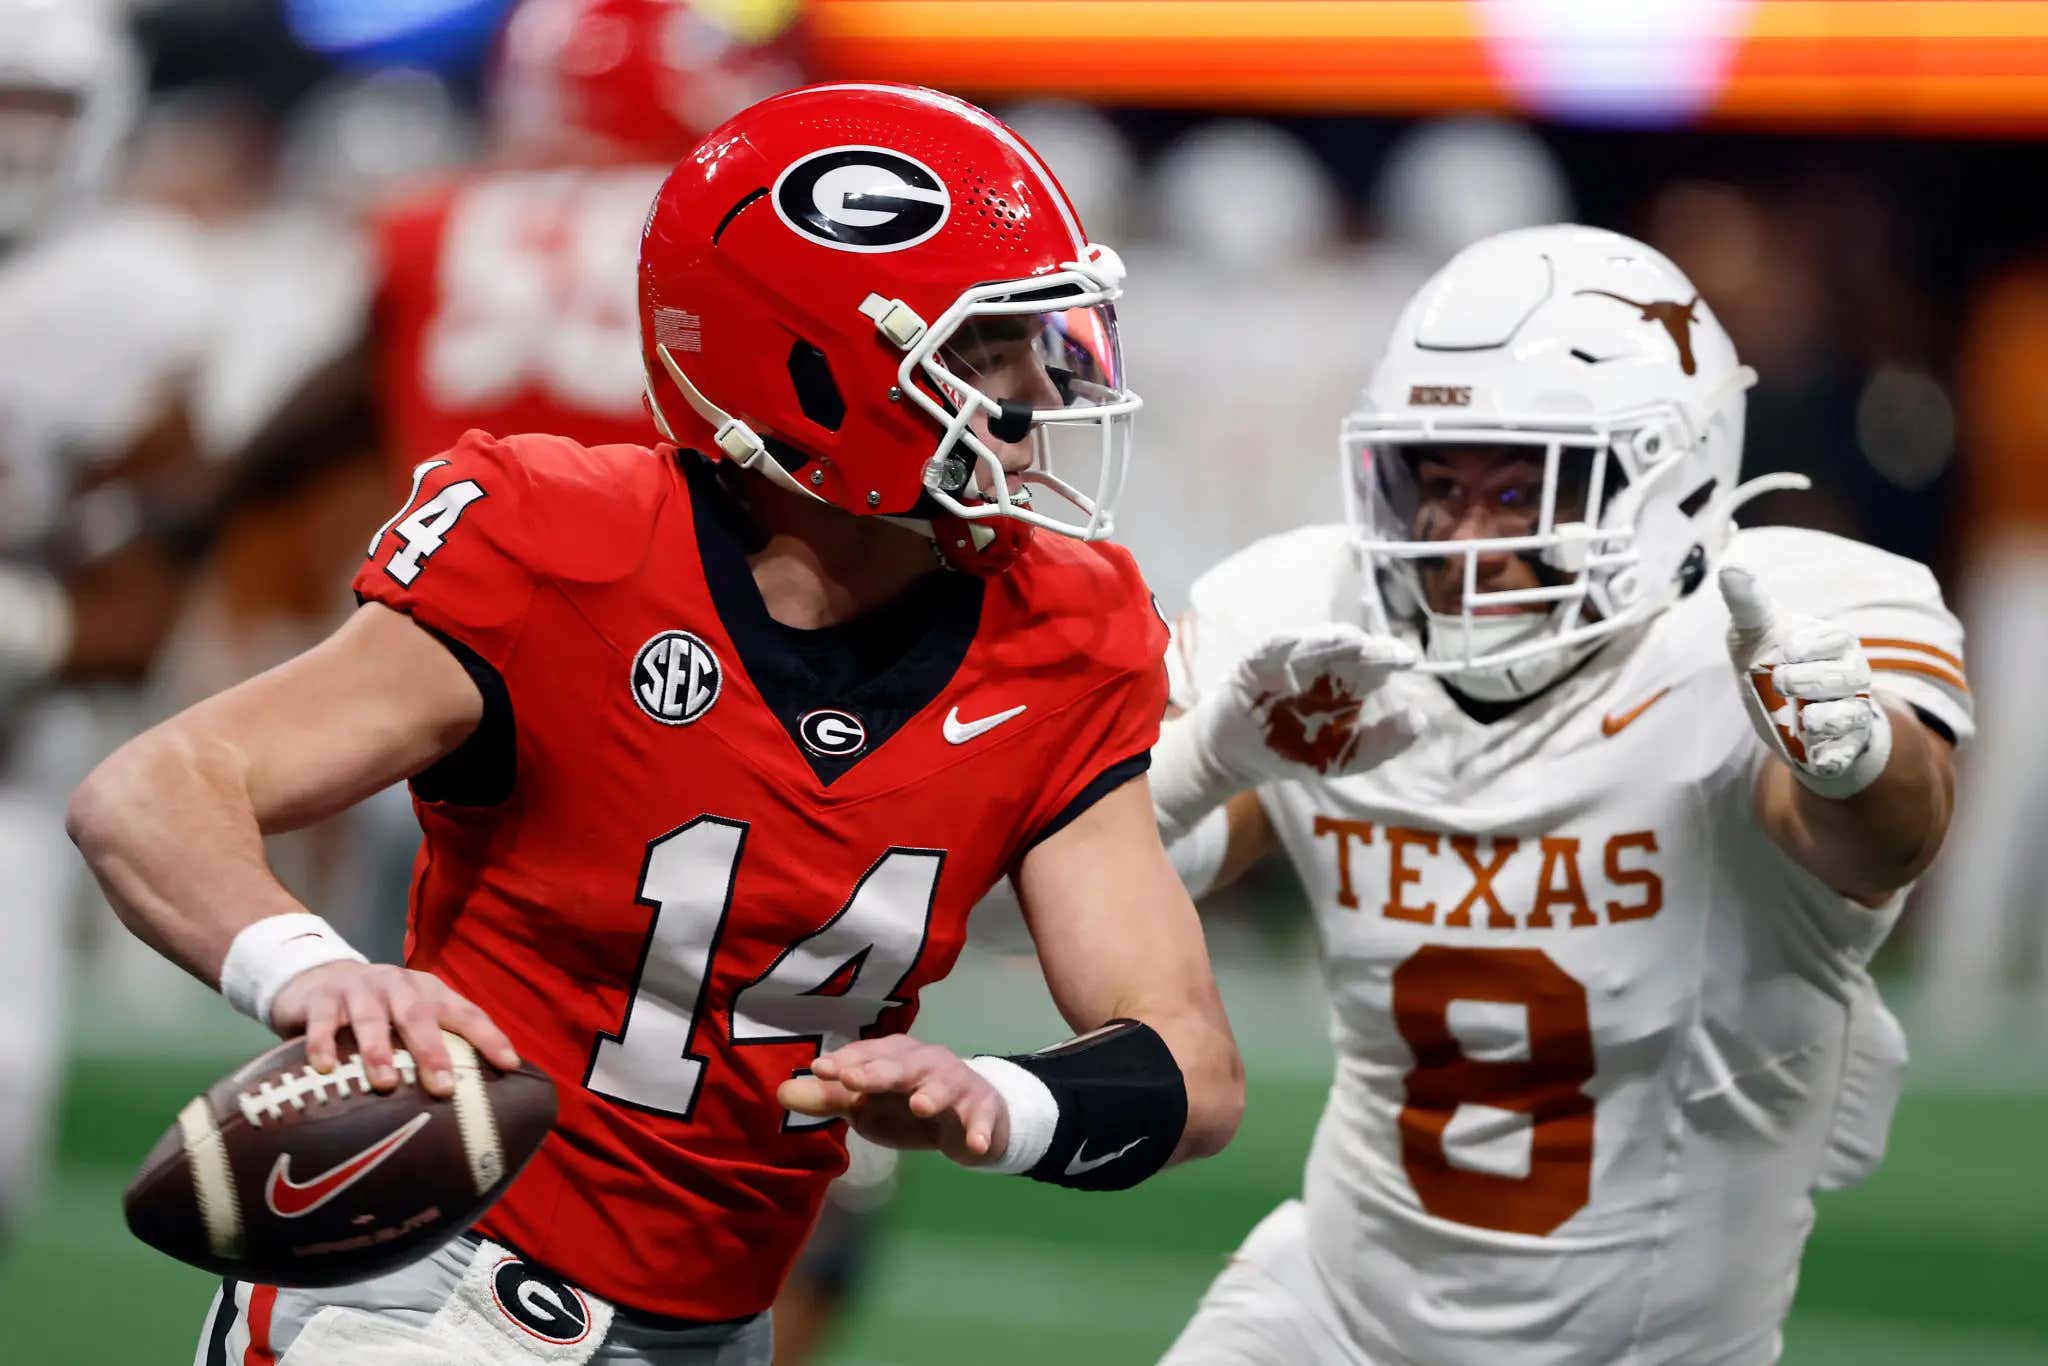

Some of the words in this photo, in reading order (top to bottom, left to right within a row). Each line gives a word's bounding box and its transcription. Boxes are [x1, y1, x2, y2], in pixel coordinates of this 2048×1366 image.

[778, 150, 945, 247] G
[639, 637, 713, 717] SEC
[802, 711, 863, 753] G
[1313, 815, 1664, 929] TEXAS
[582, 813, 948, 1133] 14
[1391, 944, 1596, 1238] 8
[494, 1261, 587, 1341] G
